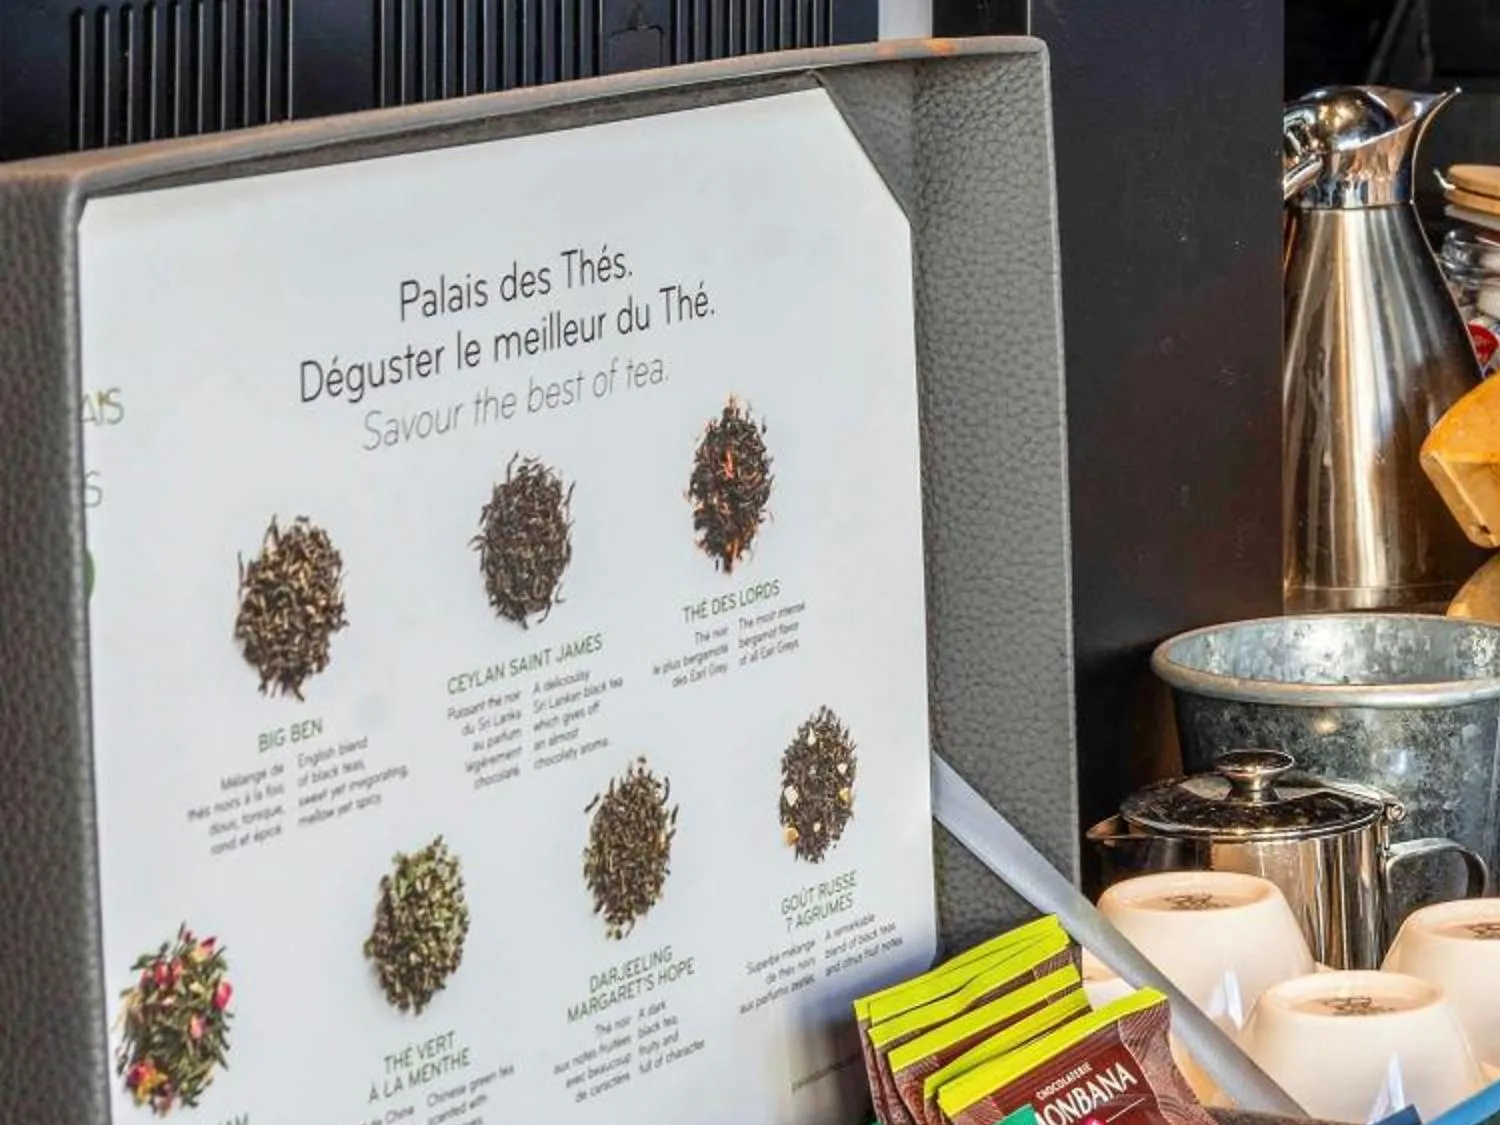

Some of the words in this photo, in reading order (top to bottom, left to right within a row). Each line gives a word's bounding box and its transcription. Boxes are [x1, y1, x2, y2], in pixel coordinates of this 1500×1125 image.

[400, 275, 489, 322] Palais
[501, 263, 551, 300] des
[562, 245, 633, 287] Thés.
[299, 345, 445, 403] Déguster
[456, 331, 481, 369] le
[495, 309, 607, 362] meilleur
[617, 298, 650, 333] du
[660, 282, 715, 322] Thé.
[362, 402, 462, 451] Savour
[474, 389, 517, 427] the
[527, 376, 583, 414] best
[593, 358, 619, 399] of
[625, 354, 670, 387] tea.
[712, 593, 737, 615] DES
[740, 579, 780, 606] LORDS
[447, 663, 505, 695] CEYLAN
[510, 648, 551, 677] SAINT
[556, 633, 603, 663] JAMES
[258, 728, 285, 752] BIG
[291, 718, 323, 742] BEN
[818, 870, 857, 897] RUSSE
[796, 892, 853, 928] AGRUMES
[589, 945, 672, 994] DARJEELING
[658, 957, 695, 985] HOPE
[417, 1030, 456, 1060] VERT
[383, 1076, 403, 1098] LA
[409, 1047, 471, 1087] MENTHE
